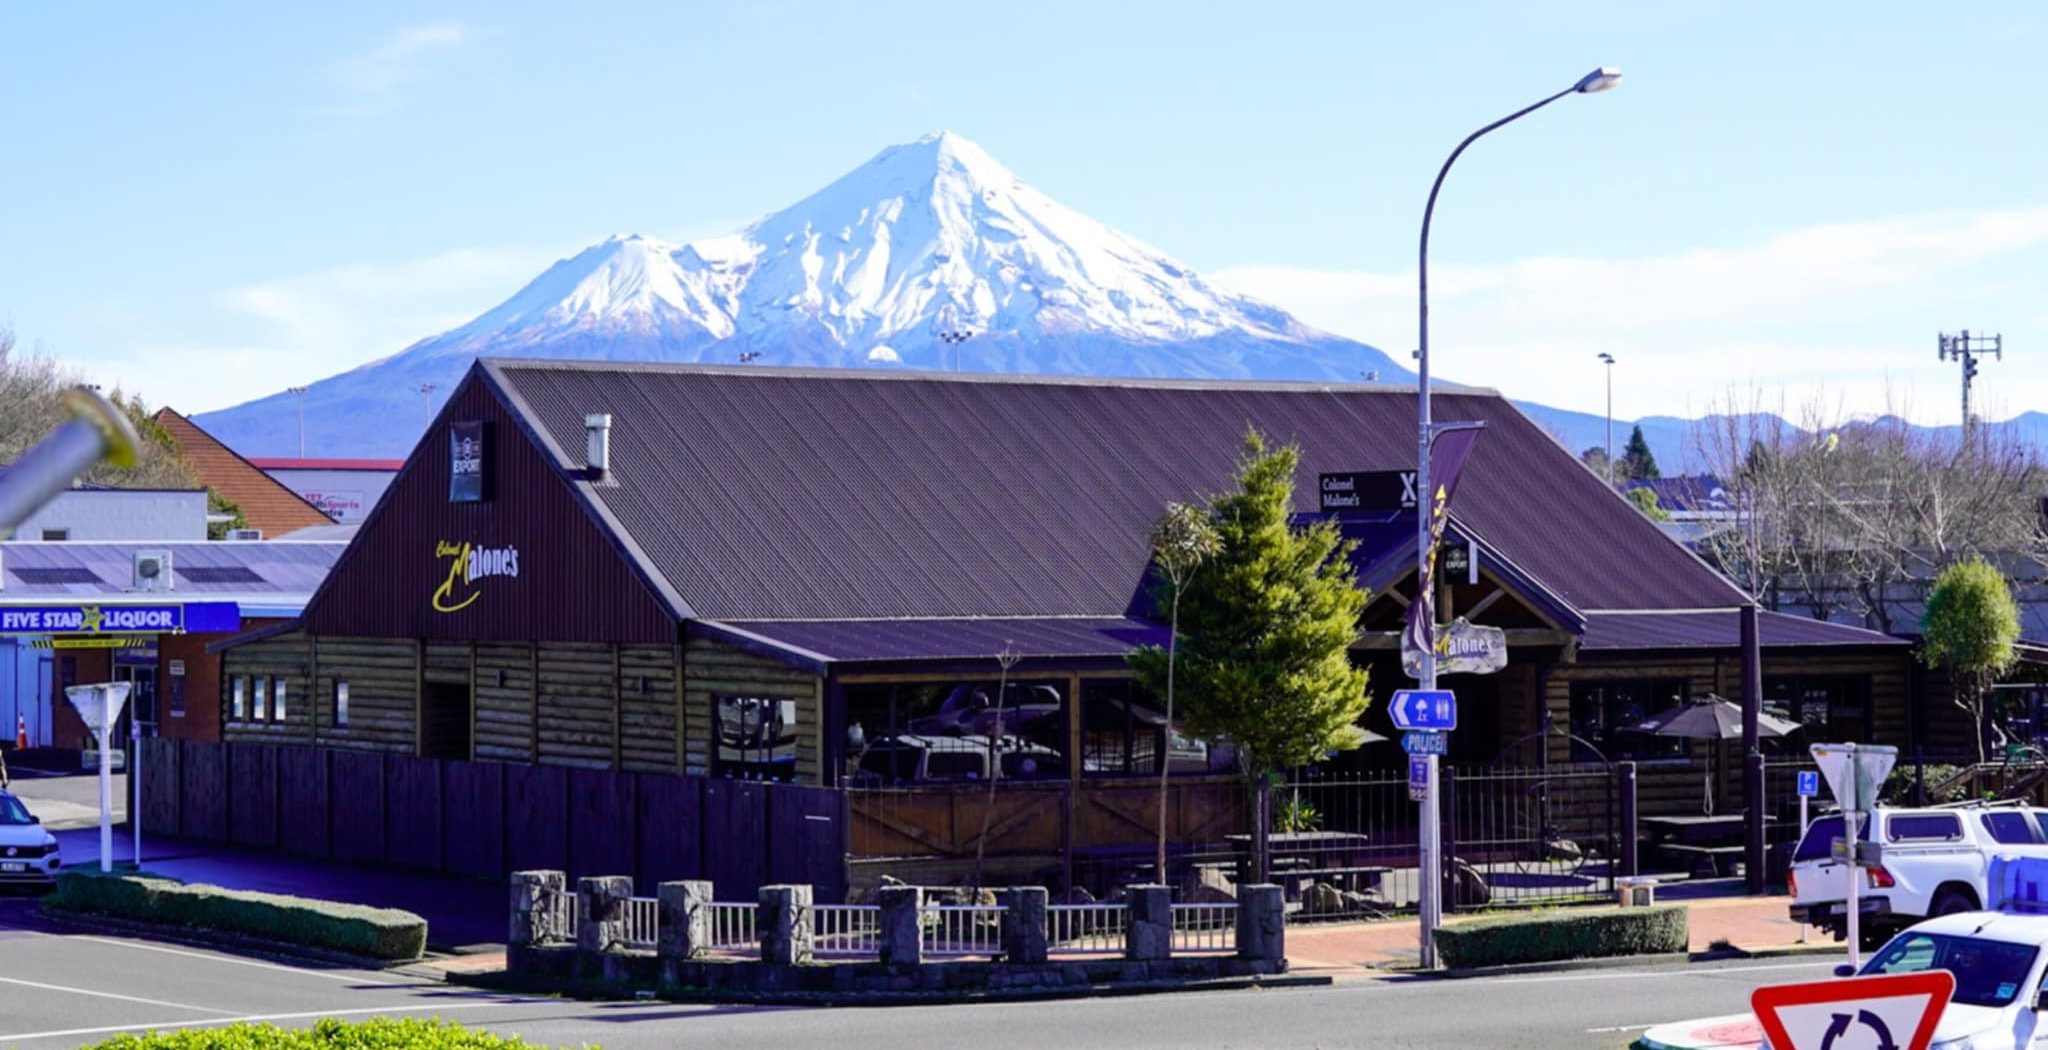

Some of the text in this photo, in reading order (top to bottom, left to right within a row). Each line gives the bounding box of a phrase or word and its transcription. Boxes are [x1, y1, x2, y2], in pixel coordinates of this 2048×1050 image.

[1322, 477, 1354, 491] Colonel
[1323, 493, 1360, 507] Malone's
[434, 541, 519, 609] Malone's
[3, 611, 173, 629] FIVE STAR LIQUOR
[1408, 734, 1443, 752] POLICE
